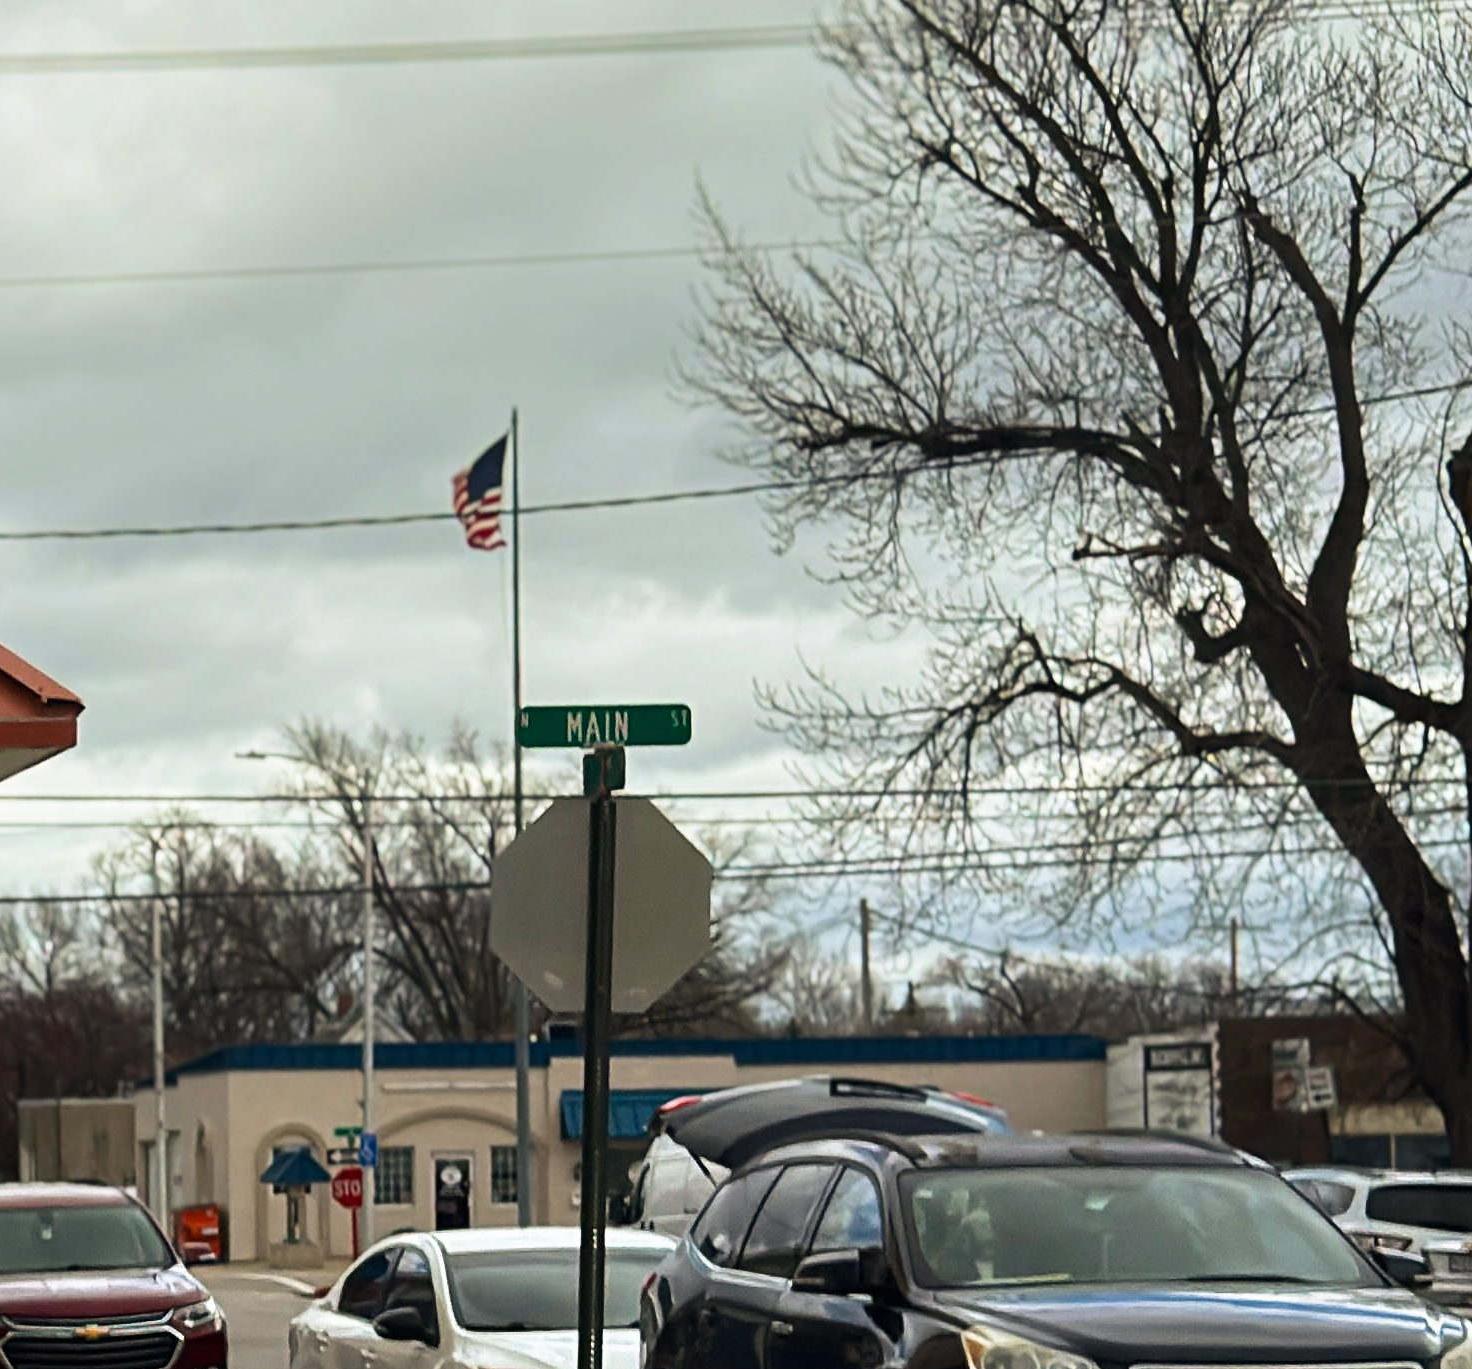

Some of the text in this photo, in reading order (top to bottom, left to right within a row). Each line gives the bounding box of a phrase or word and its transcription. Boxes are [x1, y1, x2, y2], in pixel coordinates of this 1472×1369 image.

[520, 709, 687, 747] N MAIN ST
[334, 1180, 361, 1197] STO
